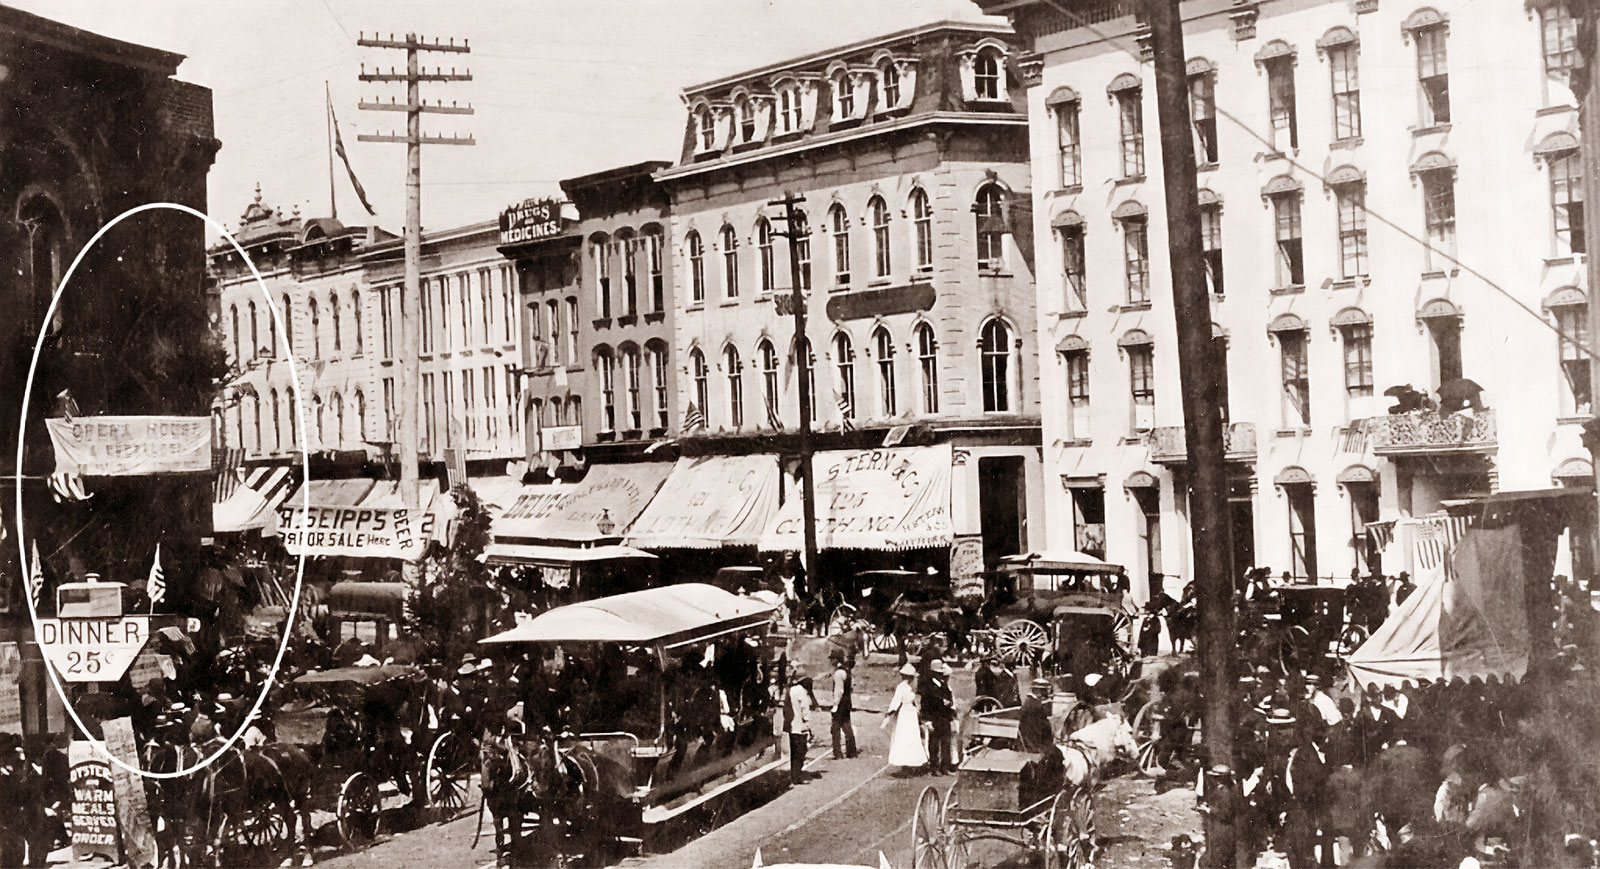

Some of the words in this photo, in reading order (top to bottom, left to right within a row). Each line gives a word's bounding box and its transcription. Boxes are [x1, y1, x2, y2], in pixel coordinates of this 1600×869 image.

[507, 204, 550, 230] DRUGS
[827, 450, 896, 481] STERN
[393, 508, 415, 551] BEER
[775, 515, 895, 536] CLTHING
[328, 531, 366, 548] SALE
[42, 621, 141, 645] DINNER
[73, 787, 114, 802] WARM
[71, 802, 116, 815] MEALS
[71, 815, 117, 828] SERVED
